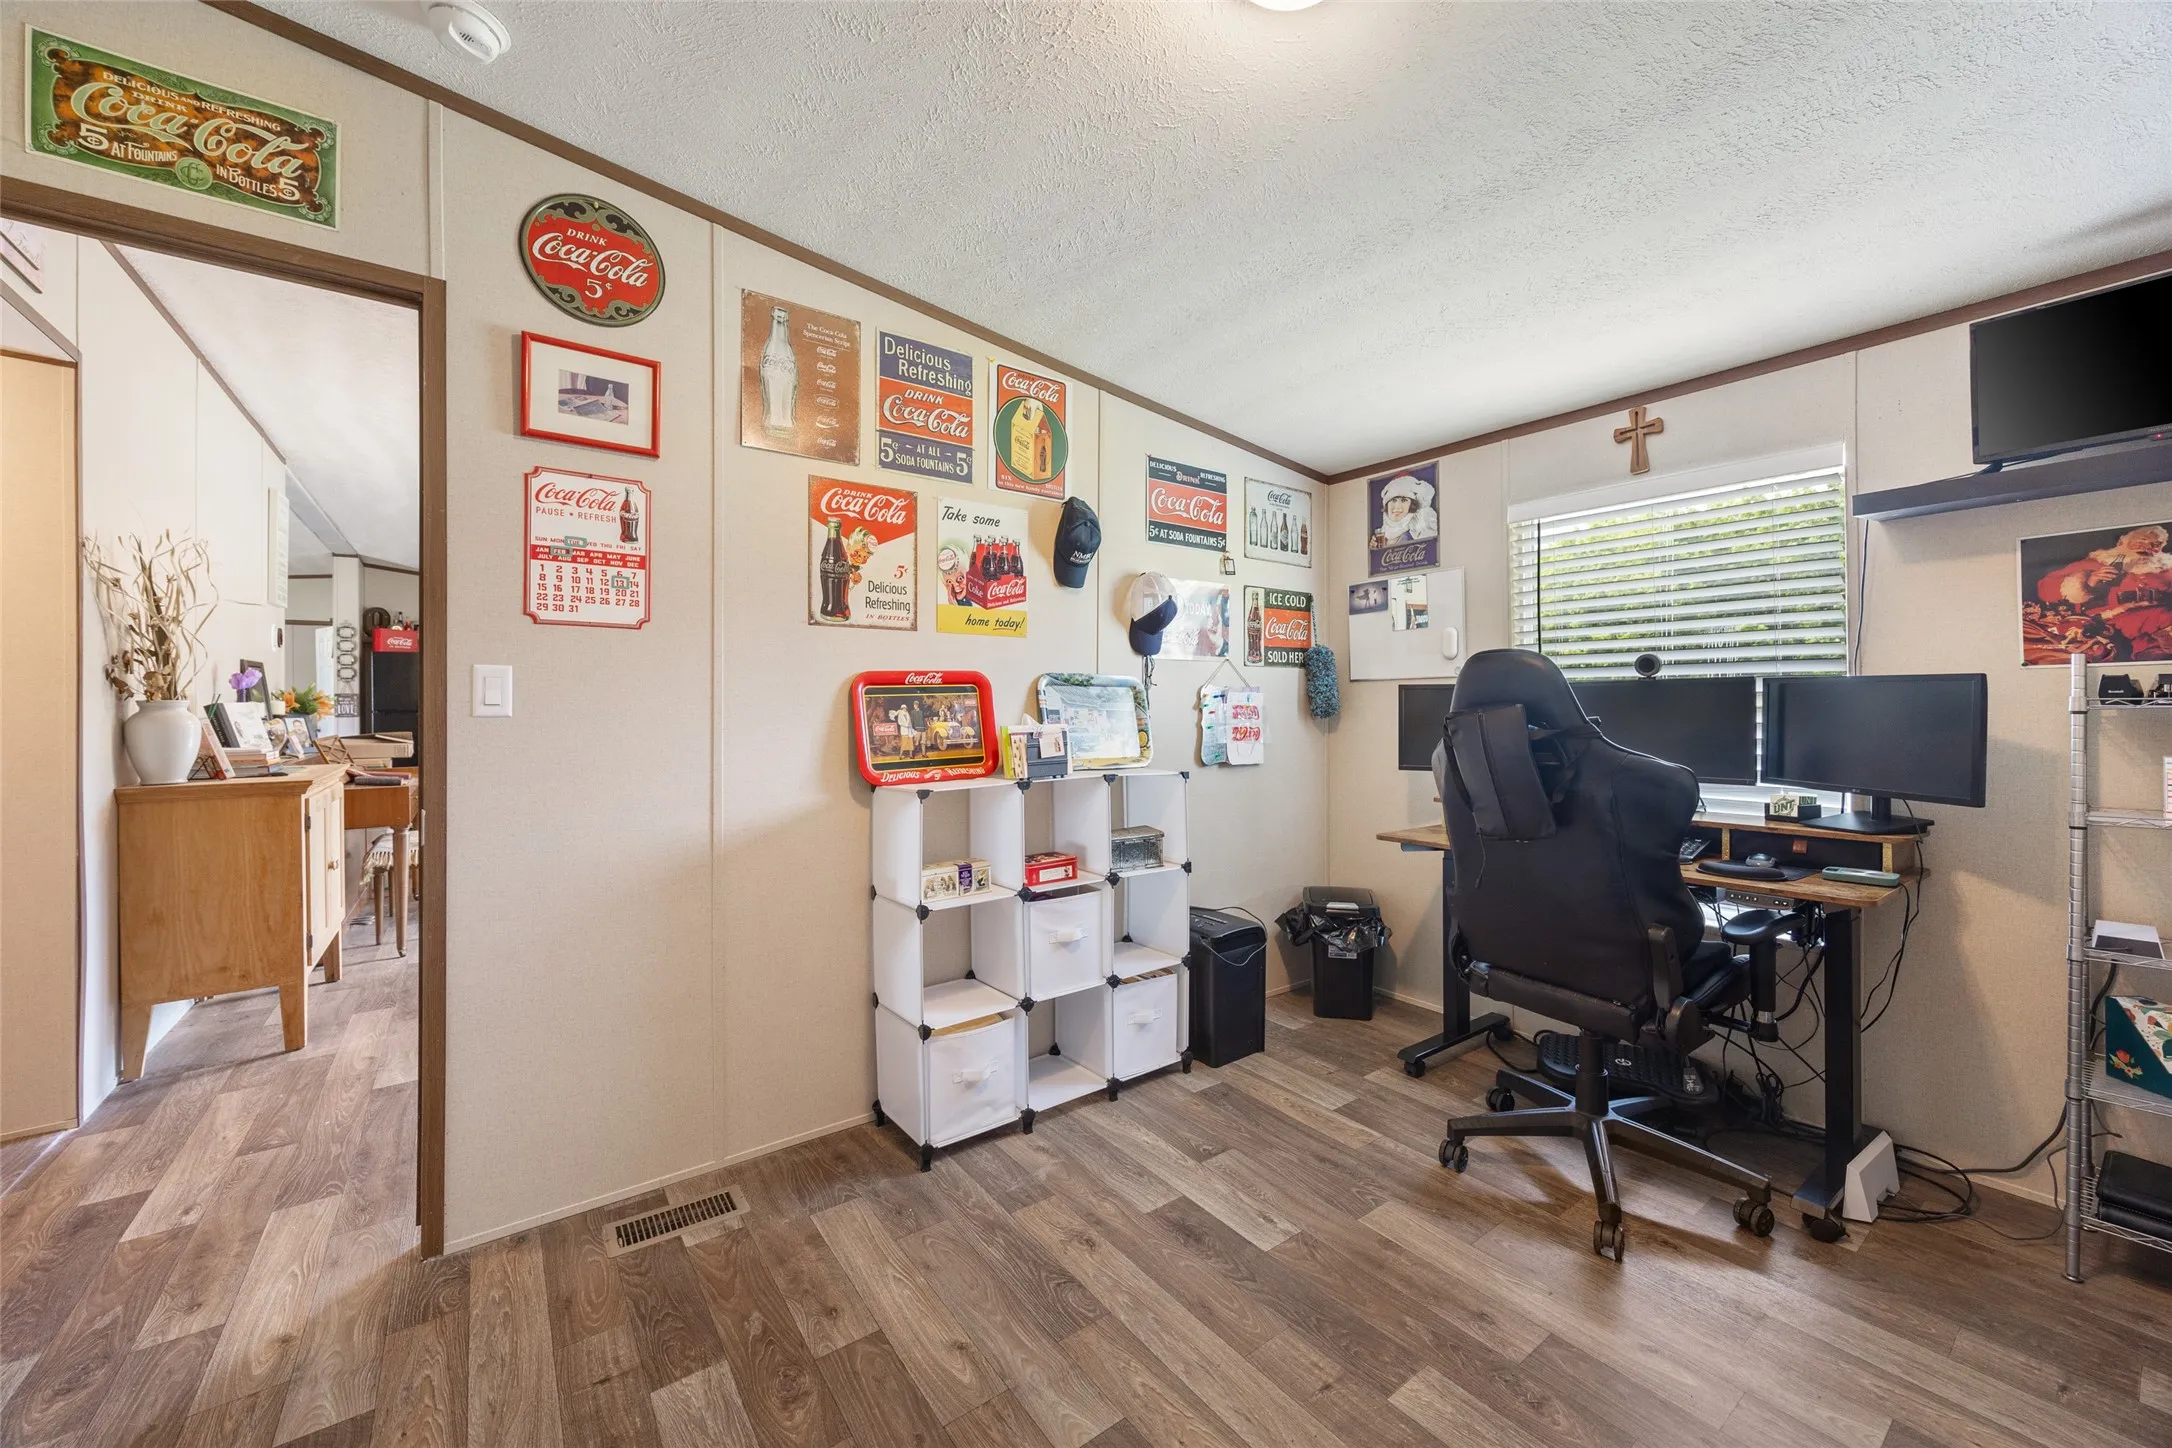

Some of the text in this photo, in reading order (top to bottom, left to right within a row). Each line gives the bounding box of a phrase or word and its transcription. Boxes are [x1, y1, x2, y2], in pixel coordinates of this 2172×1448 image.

[103, 71, 281, 132] DELICIOUS AND REFRESHING
[132, 92, 187, 112] DRINK
[71, 82, 309, 178] Coca-Cola
[111, 142, 125, 158] AT
[125, 141, 177, 162] FOUNTAINS
[216, 165, 228, 177] IN
[228, 166, 278, 197] BOTTLES
[567, 228, 608, 246] DRINK
[532, 232, 653, 287] Coca-Cola
[585, 279, 612, 298] 5¢
[807, 322, 847, 339] The Coca Cola
[885, 337, 951, 371] Delicious
[899, 359, 972, 396] Refreshing
[1003, 372, 1060, 403] Coca-Cola
[905, 389, 945, 405] DRINK
[883, 395, 971, 438] Coca-Cola
[881, 438, 899, 462] 5¢
[917, 444, 925, 454] AT
[928, 446, 940, 457] ALL
[896, 453, 955, 474] SODA FOUNTAINS
[1150, 461, 1177, 472] DELICIOUS
[1176, 471, 1200, 485] DRINK
[535, 482, 621, 512] Coca-Cola
[843, 490, 873, 499] DRINK
[1268, 490, 1292, 506] Coca-Cola
[536, 507, 565, 517] PAUSE
[578, 512, 617, 523] REFRESH
[821, 488, 910, 525] Coca-Cola
[1151, 488, 1225, 525] Coca-Cola
[942, 506, 1001, 527] Take some
[1150, 526, 1226, 548] 5¢ AT SODA FOUNTAINS 5¢
[1382, 543, 1427, 566] Coca-Cola
[540, 564, 545, 572] 1
[556, 566, 563, 574] 2
[572, 567, 578, 575] 3
[586, 568, 593, 576] 4
[631, 572, 637, 580] 7
[572, 576, 581, 584] 10
[586, 577, 593, 585] 11
[538, 583, 547, 591] 15
[553, 584, 563, 592] 16
[585, 587, 594, 595] 18
[600, 588, 609, 596] 19
[616, 589, 627, 597] 20
[630, 590, 639, 598] 21
[868, 581, 907, 595] Delicious
[968, 582, 984, 598] Coke
[988, 579, 1026, 600] Coca-Cola
[537, 593, 548, 601] 22
[553, 594, 564, 602] 23
[571, 595, 582, 603] 24
[585, 596, 596, 604] 25
[866, 597, 910, 614] Refreshing
[1270, 593, 1306, 607] ICE COLD
[537, 603, 579, 613] 29 30 31
[878, 614, 910, 622] BOTTLES
[965, 614, 1025, 632] home today!
[1265, 617, 1309, 640] Coca-Cola
[1268, 651, 1304, 663] SOLD HER
[905, 672, 944, 685] Coca-Cola
[338, 705, 355, 714] LOVE
[881, 771, 920, 782] DELICIOUS
[945, 767, 985, 776] REFRESHING
[1774, 799, 1795, 814] UNT
[1800, 796, 1817, 805] UNT
